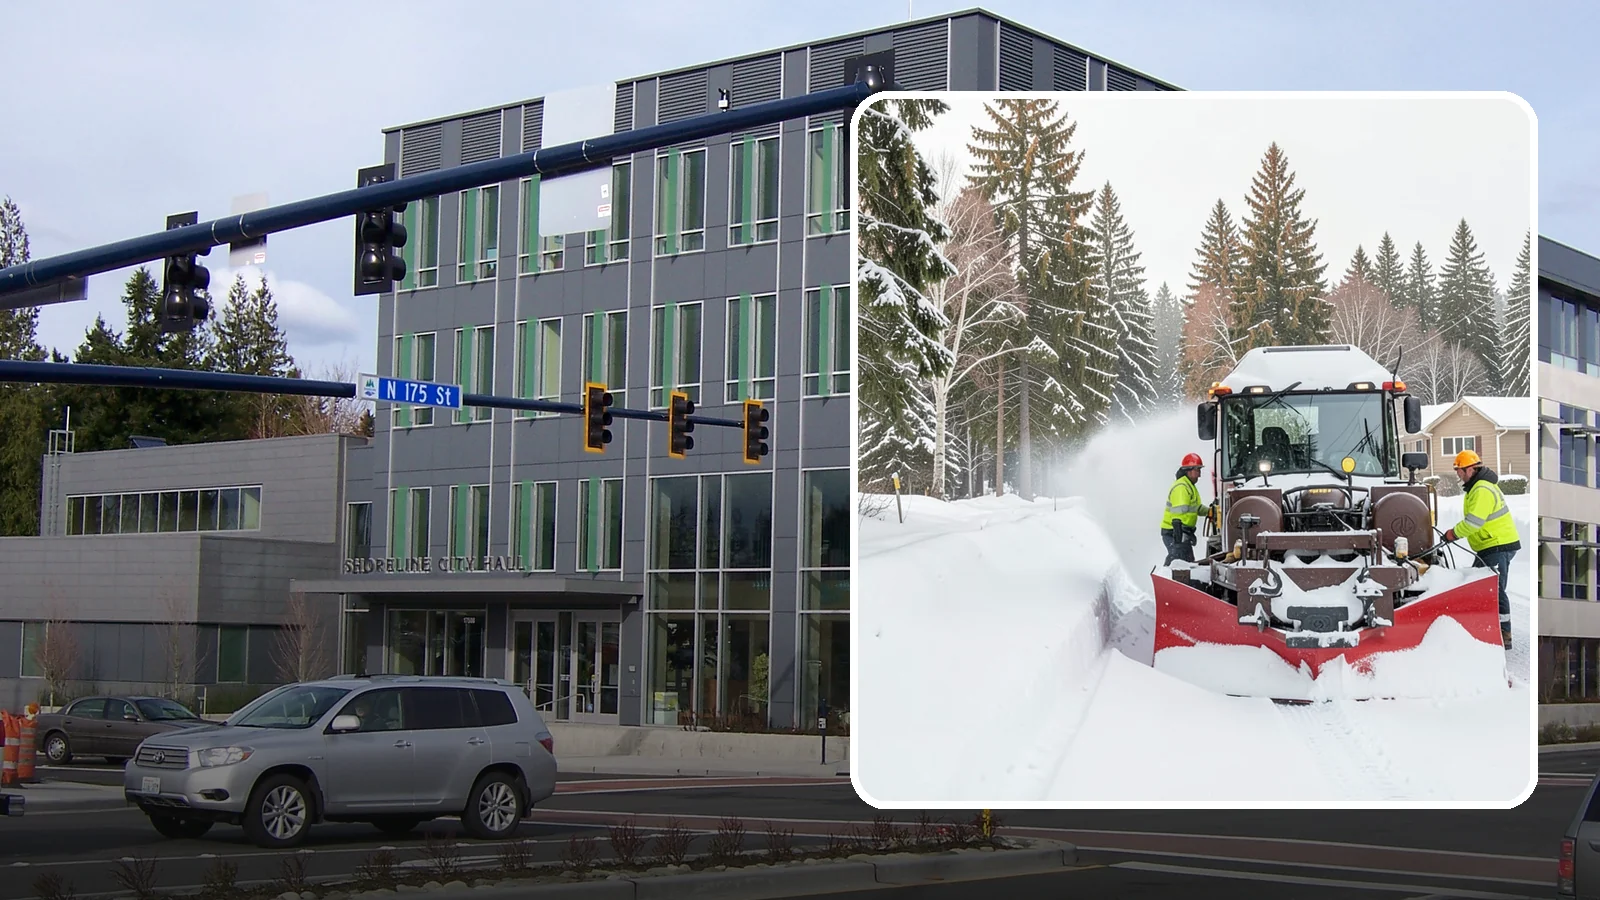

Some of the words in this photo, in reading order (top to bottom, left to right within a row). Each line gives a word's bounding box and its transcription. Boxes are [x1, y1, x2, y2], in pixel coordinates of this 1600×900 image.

[387, 380, 396, 400] N
[405, 382, 427, 403] 175
[436, 386, 451, 406] St
[344, 556, 432, 574] SHORELINE
[438, 556, 475, 572] CITY
[483, 555, 525, 572] HALL
